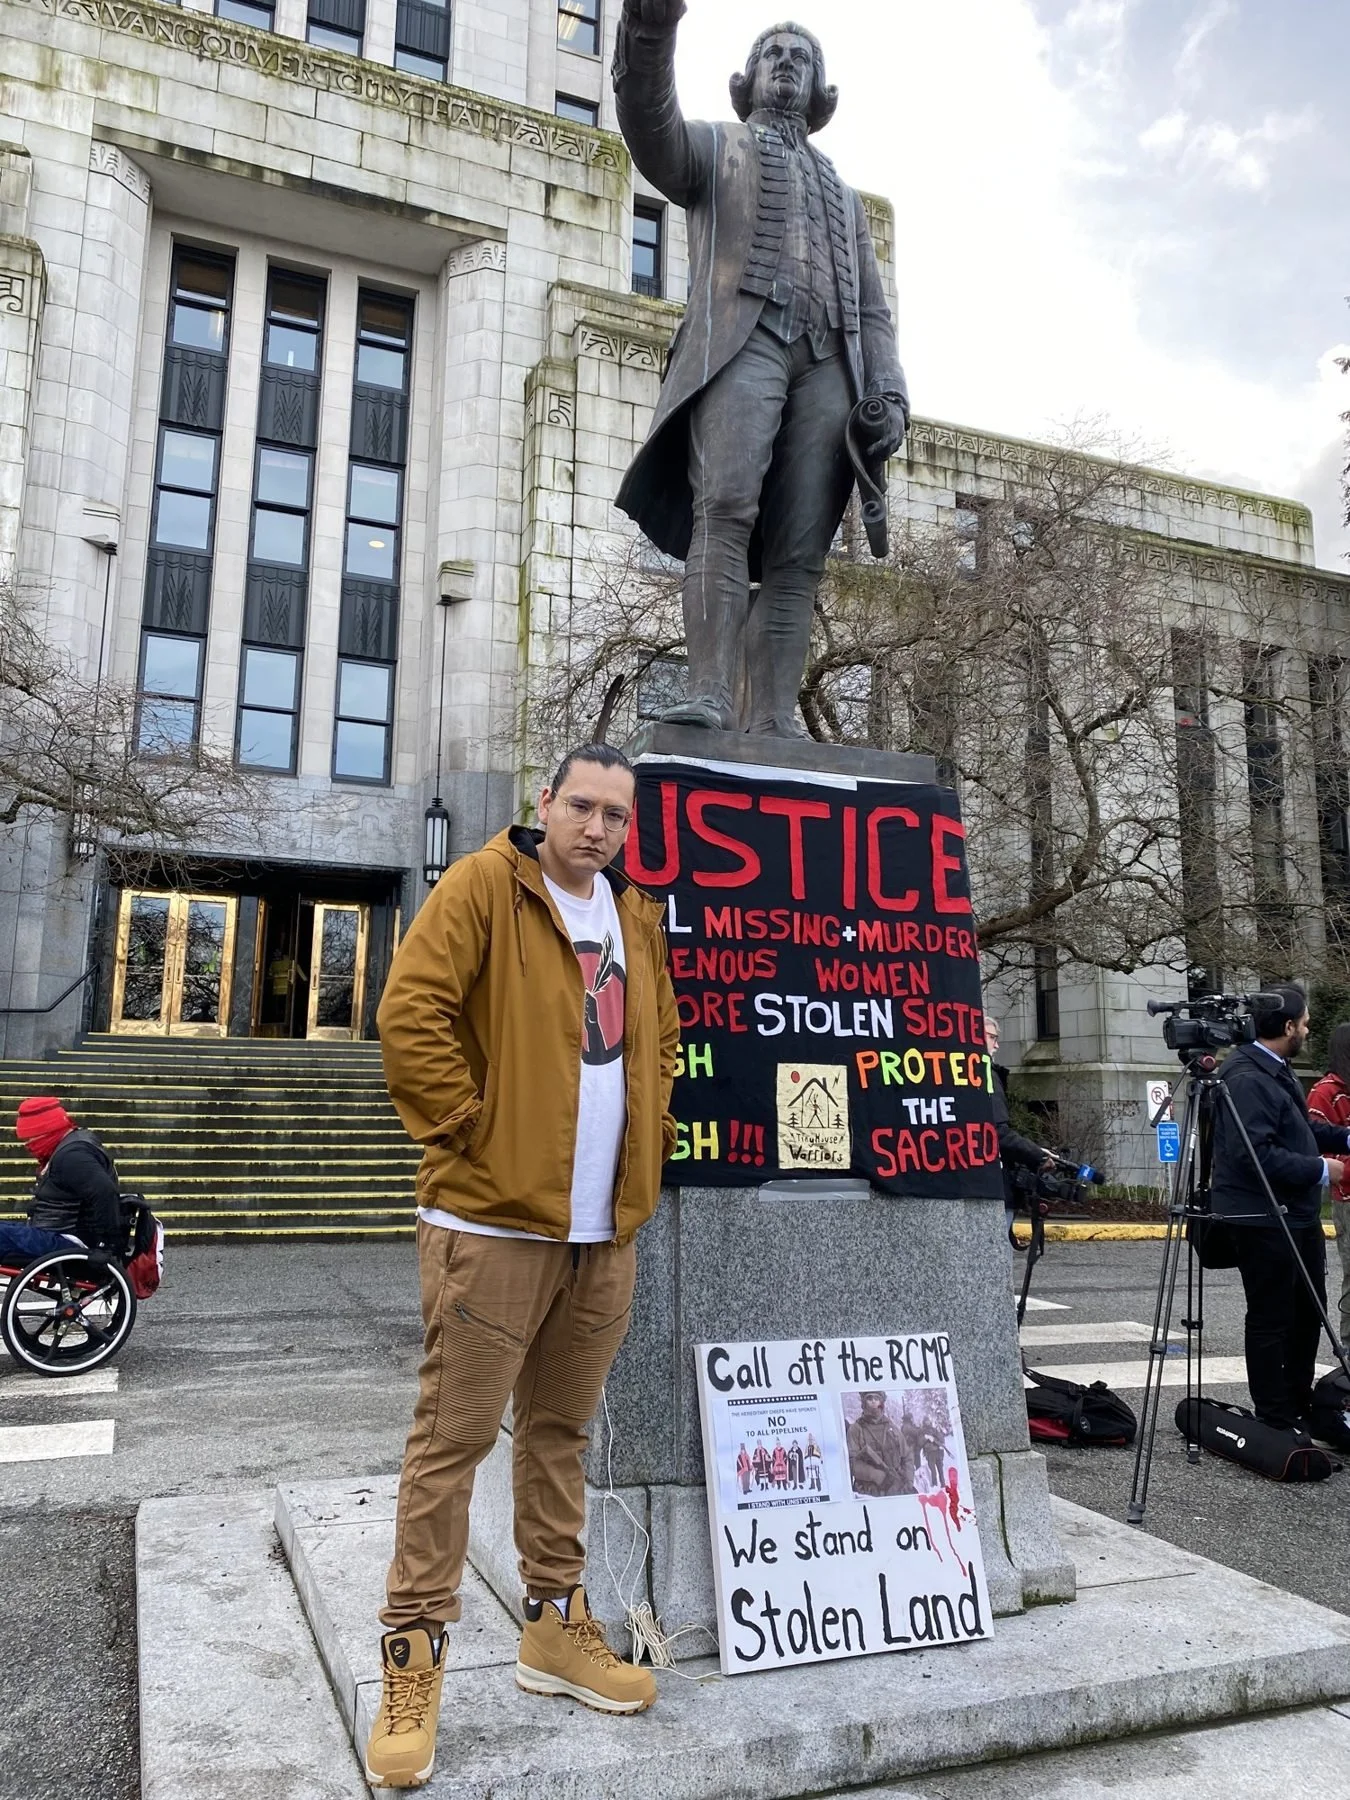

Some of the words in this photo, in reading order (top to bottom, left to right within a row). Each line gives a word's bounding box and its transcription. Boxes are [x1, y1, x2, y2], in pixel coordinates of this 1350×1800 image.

[102, 4, 316, 81] VANCOUVER
[336, 72, 411, 115] CITY
[663, 894, 692, 933] L
[665, 947, 777, 985] ENOUS
[815, 958, 930, 996] WOMEN
[754, 992, 894, 1039] STOLEN
[855, 1047, 994, 1094] PROTECT
[902, 1096, 957, 1125] THE
[789, 1144, 843, 1162] Warriors
[871, 1122, 998, 1177] SACRED
[707, 1346, 772, 1392] Call
[788, 1341, 826, 1385] off
[838, 1341, 883, 1382] the
[885, 1336, 951, 1382] RCMP
[767, 1416, 786, 1427] NO
[771, 1426, 808, 1435] PIPELINES
[724, 1518, 778, 1567] We
[795, 1505, 873, 1560] stand
[896, 1526, 932, 1551] on
[731, 1581, 866, 1661] Stolen
[879, 1562, 985, 1645] Land
